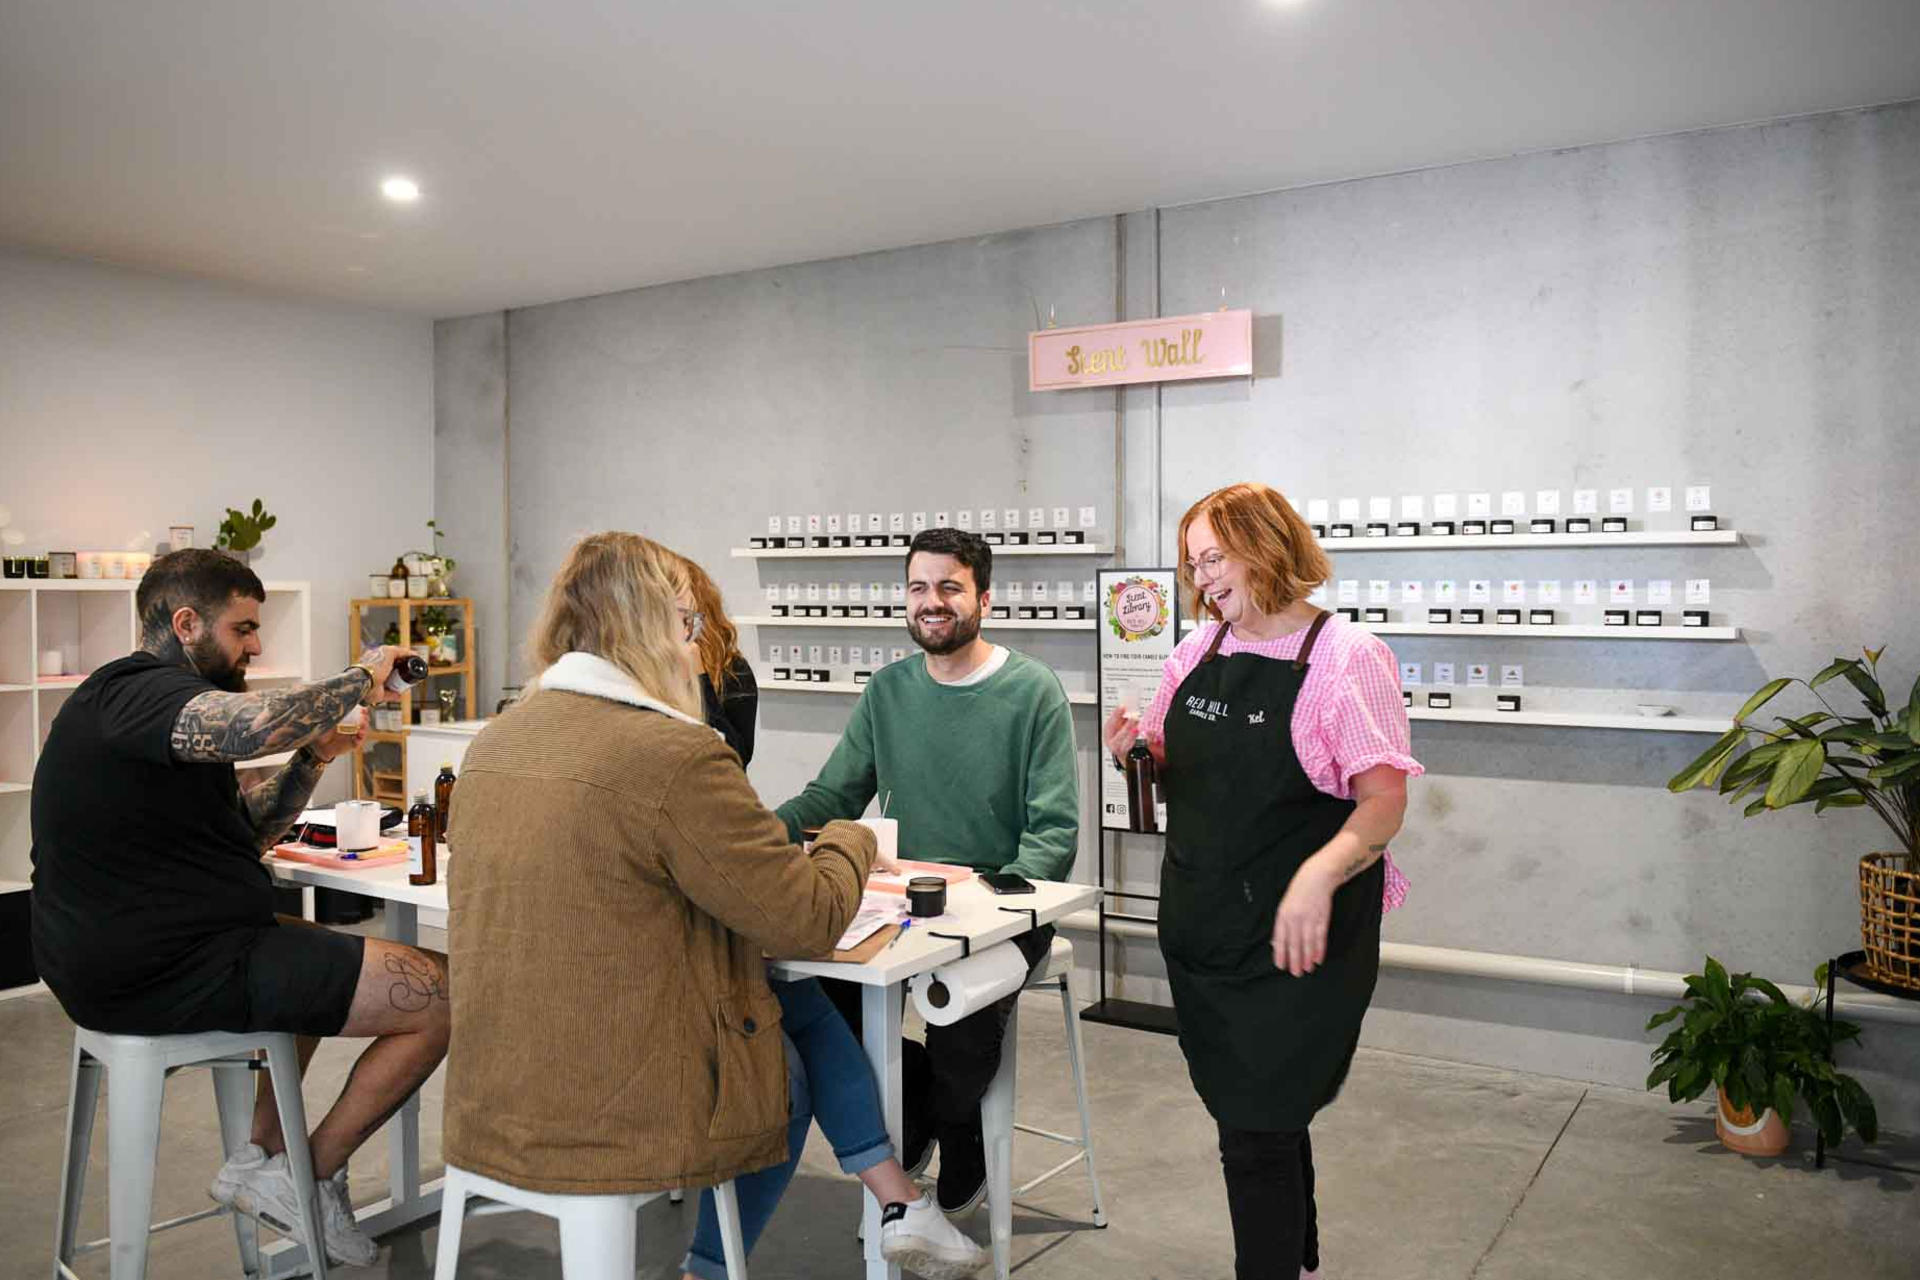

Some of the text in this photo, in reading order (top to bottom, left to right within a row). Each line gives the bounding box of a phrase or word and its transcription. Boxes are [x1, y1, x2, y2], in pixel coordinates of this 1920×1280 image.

[1066, 328, 1207, 375] Scent Wall
[1122, 601, 1152, 614] Library
[1185, 695, 1228, 717] RED HILL
